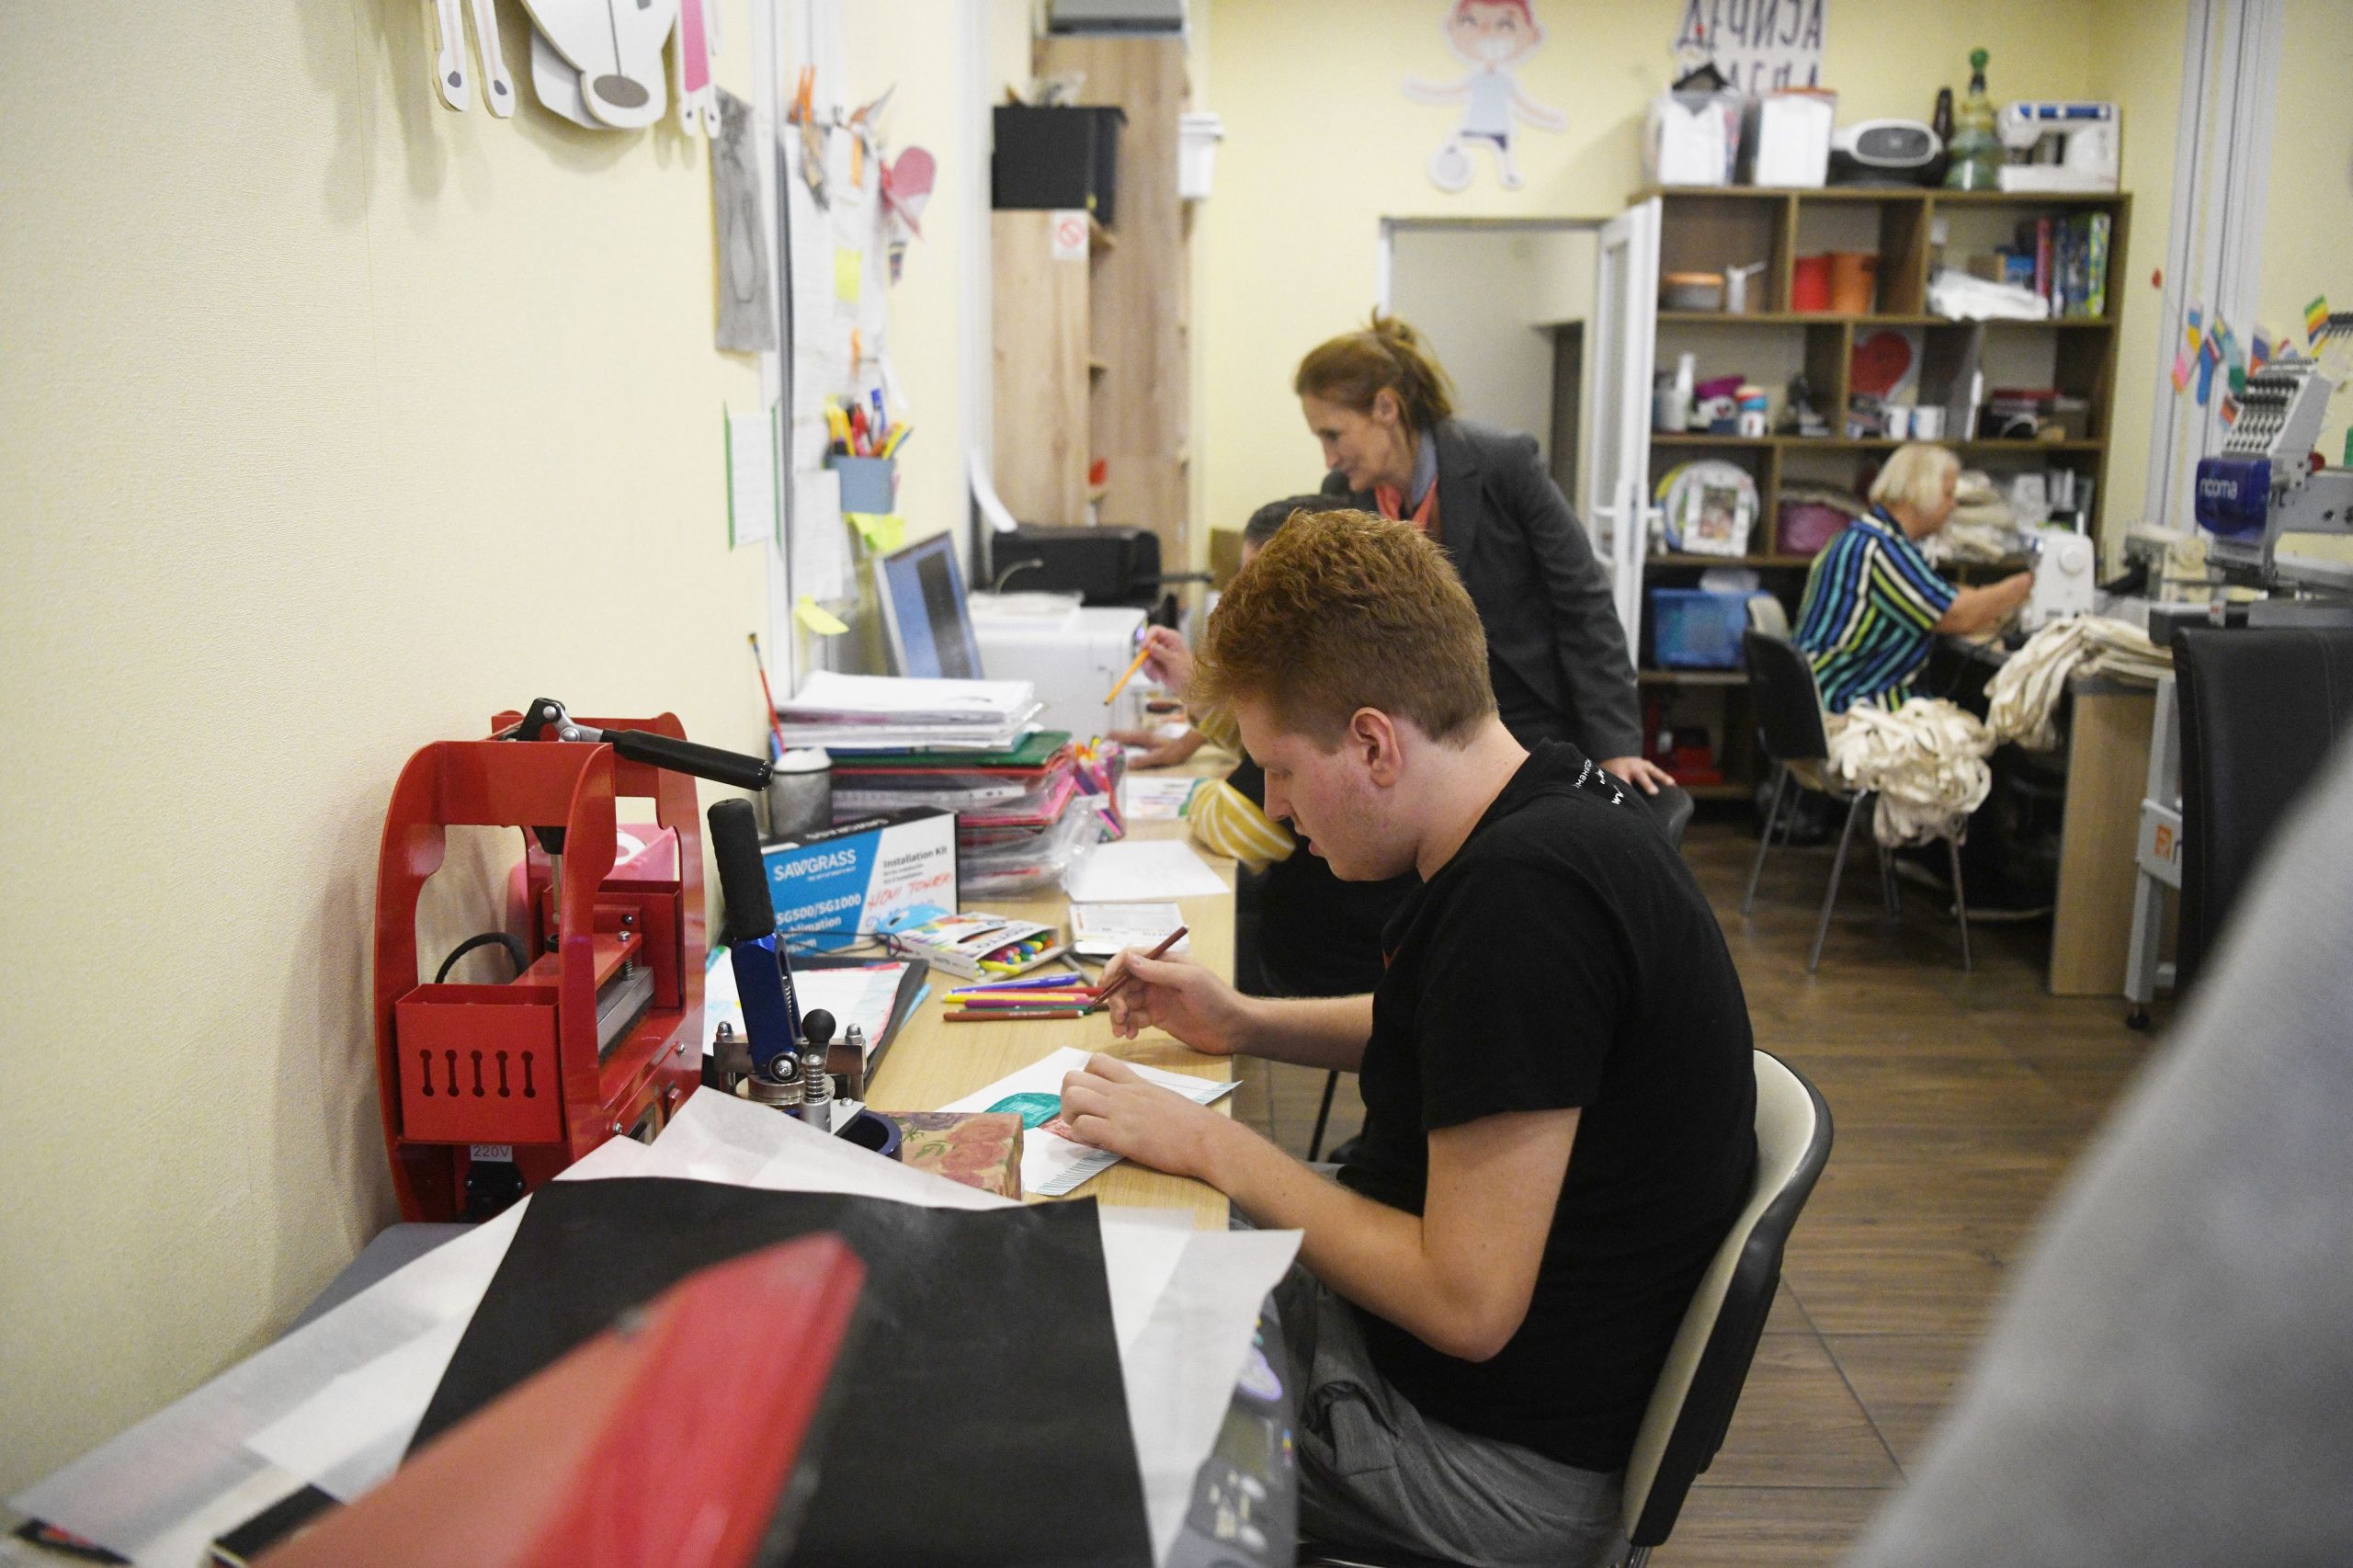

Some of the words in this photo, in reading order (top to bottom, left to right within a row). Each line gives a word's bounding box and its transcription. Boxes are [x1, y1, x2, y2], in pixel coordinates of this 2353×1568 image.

[774, 848, 857, 881] SAWGRASS
[883, 848, 934, 869] Installation
[936, 846, 948, 856] Kit
[776, 892, 862, 926] SG500/SG1000
[472, 1145, 510, 1158] 220V
